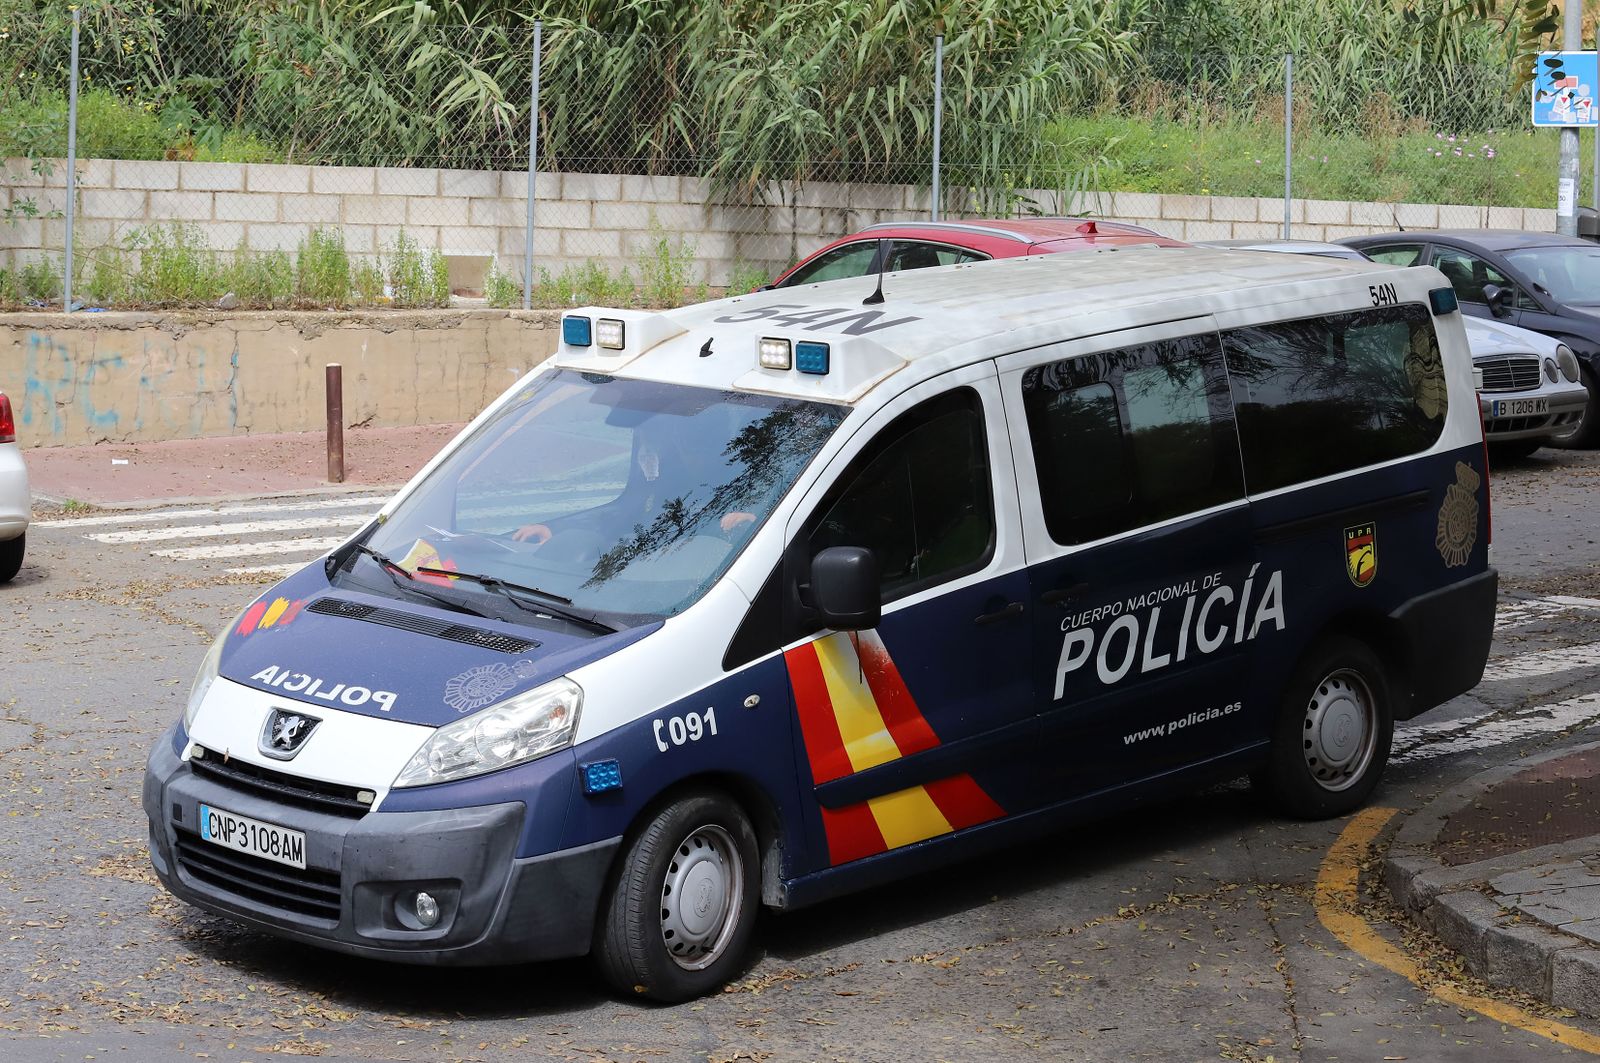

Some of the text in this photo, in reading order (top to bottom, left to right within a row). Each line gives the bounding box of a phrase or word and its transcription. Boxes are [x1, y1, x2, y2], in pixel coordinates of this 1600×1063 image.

[1369, 282, 1399, 307] 54N
[713, 304, 924, 336] 54N
[1500, 399, 1547, 415] B 1206 WX
[1060, 571, 1223, 632] CUERPO NACIONAL DE
[1053, 562, 1286, 701] POLICÍA
[668, 706, 718, 746] 091
